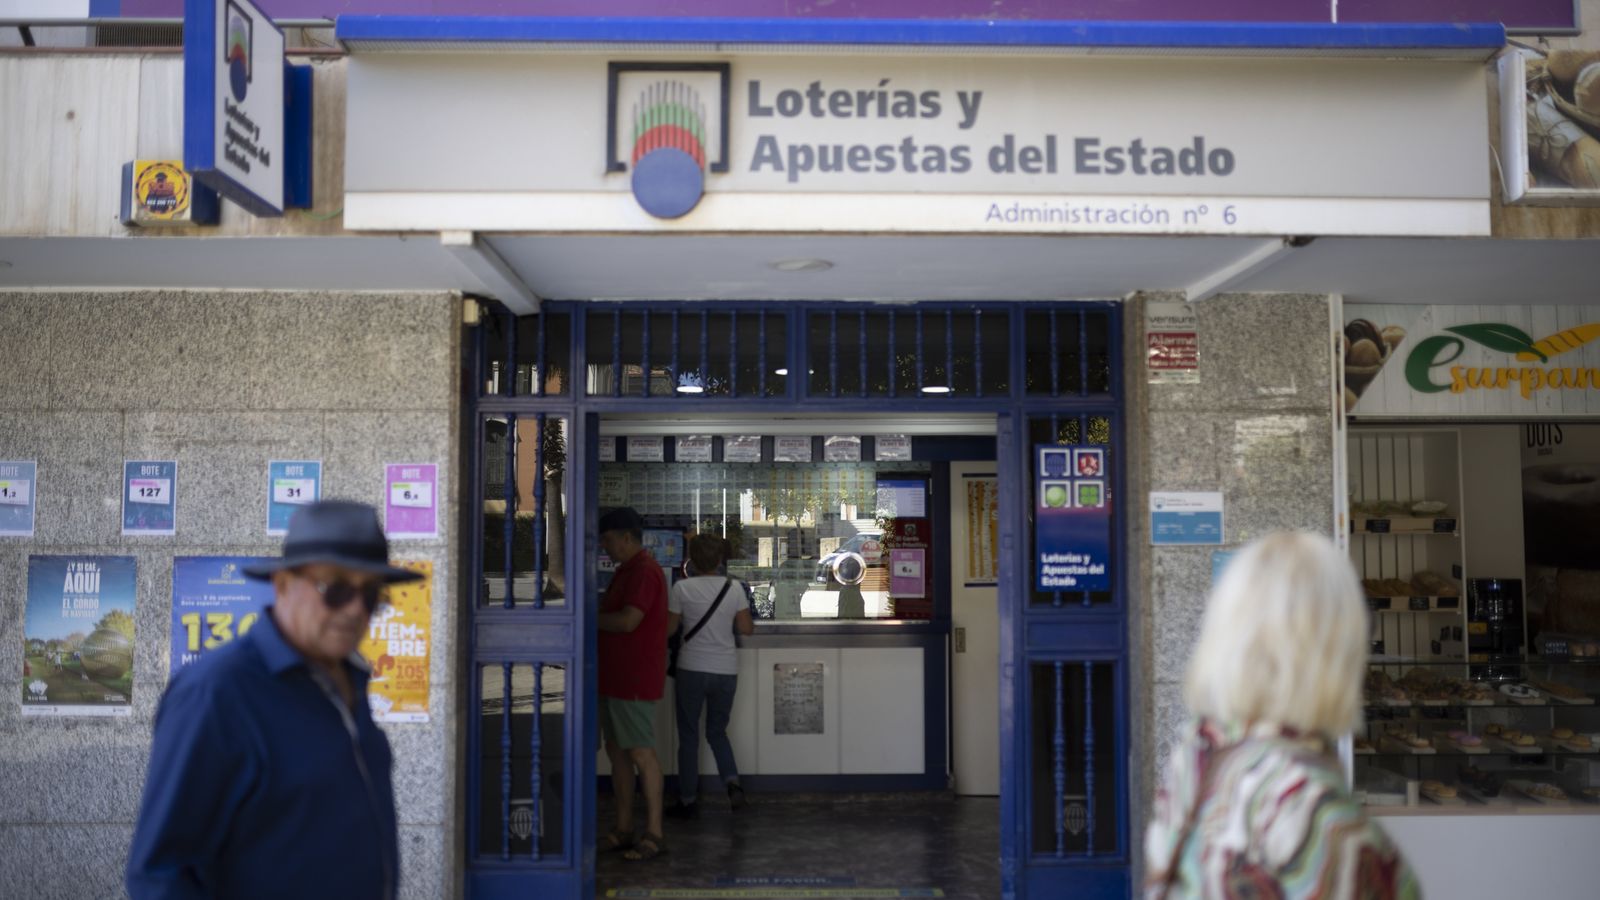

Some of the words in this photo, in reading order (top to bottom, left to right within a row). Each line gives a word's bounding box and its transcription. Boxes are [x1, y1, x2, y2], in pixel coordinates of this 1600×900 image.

[747, 78, 943, 118] Loterías
[956, 89, 983, 130] y
[749, 134, 973, 183] Apuestas
[987, 134, 1057, 175] del
[1073, 136, 1236, 176] Estado
[985, 203, 1170, 225] Administración
[1223, 205, 1237, 225] 6
[141, 466, 160, 476] BOTE
[285, 466, 304, 476] BOTE
[402, 468, 421, 479] BOTE
[139, 487, 162, 497] 127
[287, 488, 301, 498] 31
[1041, 552, 1082, 563] Loterías
[1083, 554, 1091, 566] y
[1041, 564, 1088, 576] Apuestas
[1089, 563, 1104, 575] del
[63, 567, 101, 594] AQUÍ
[1041, 576, 1077, 587] Estado
[62, 598, 71, 609] EL
[387, 639, 427, 657] BRE
